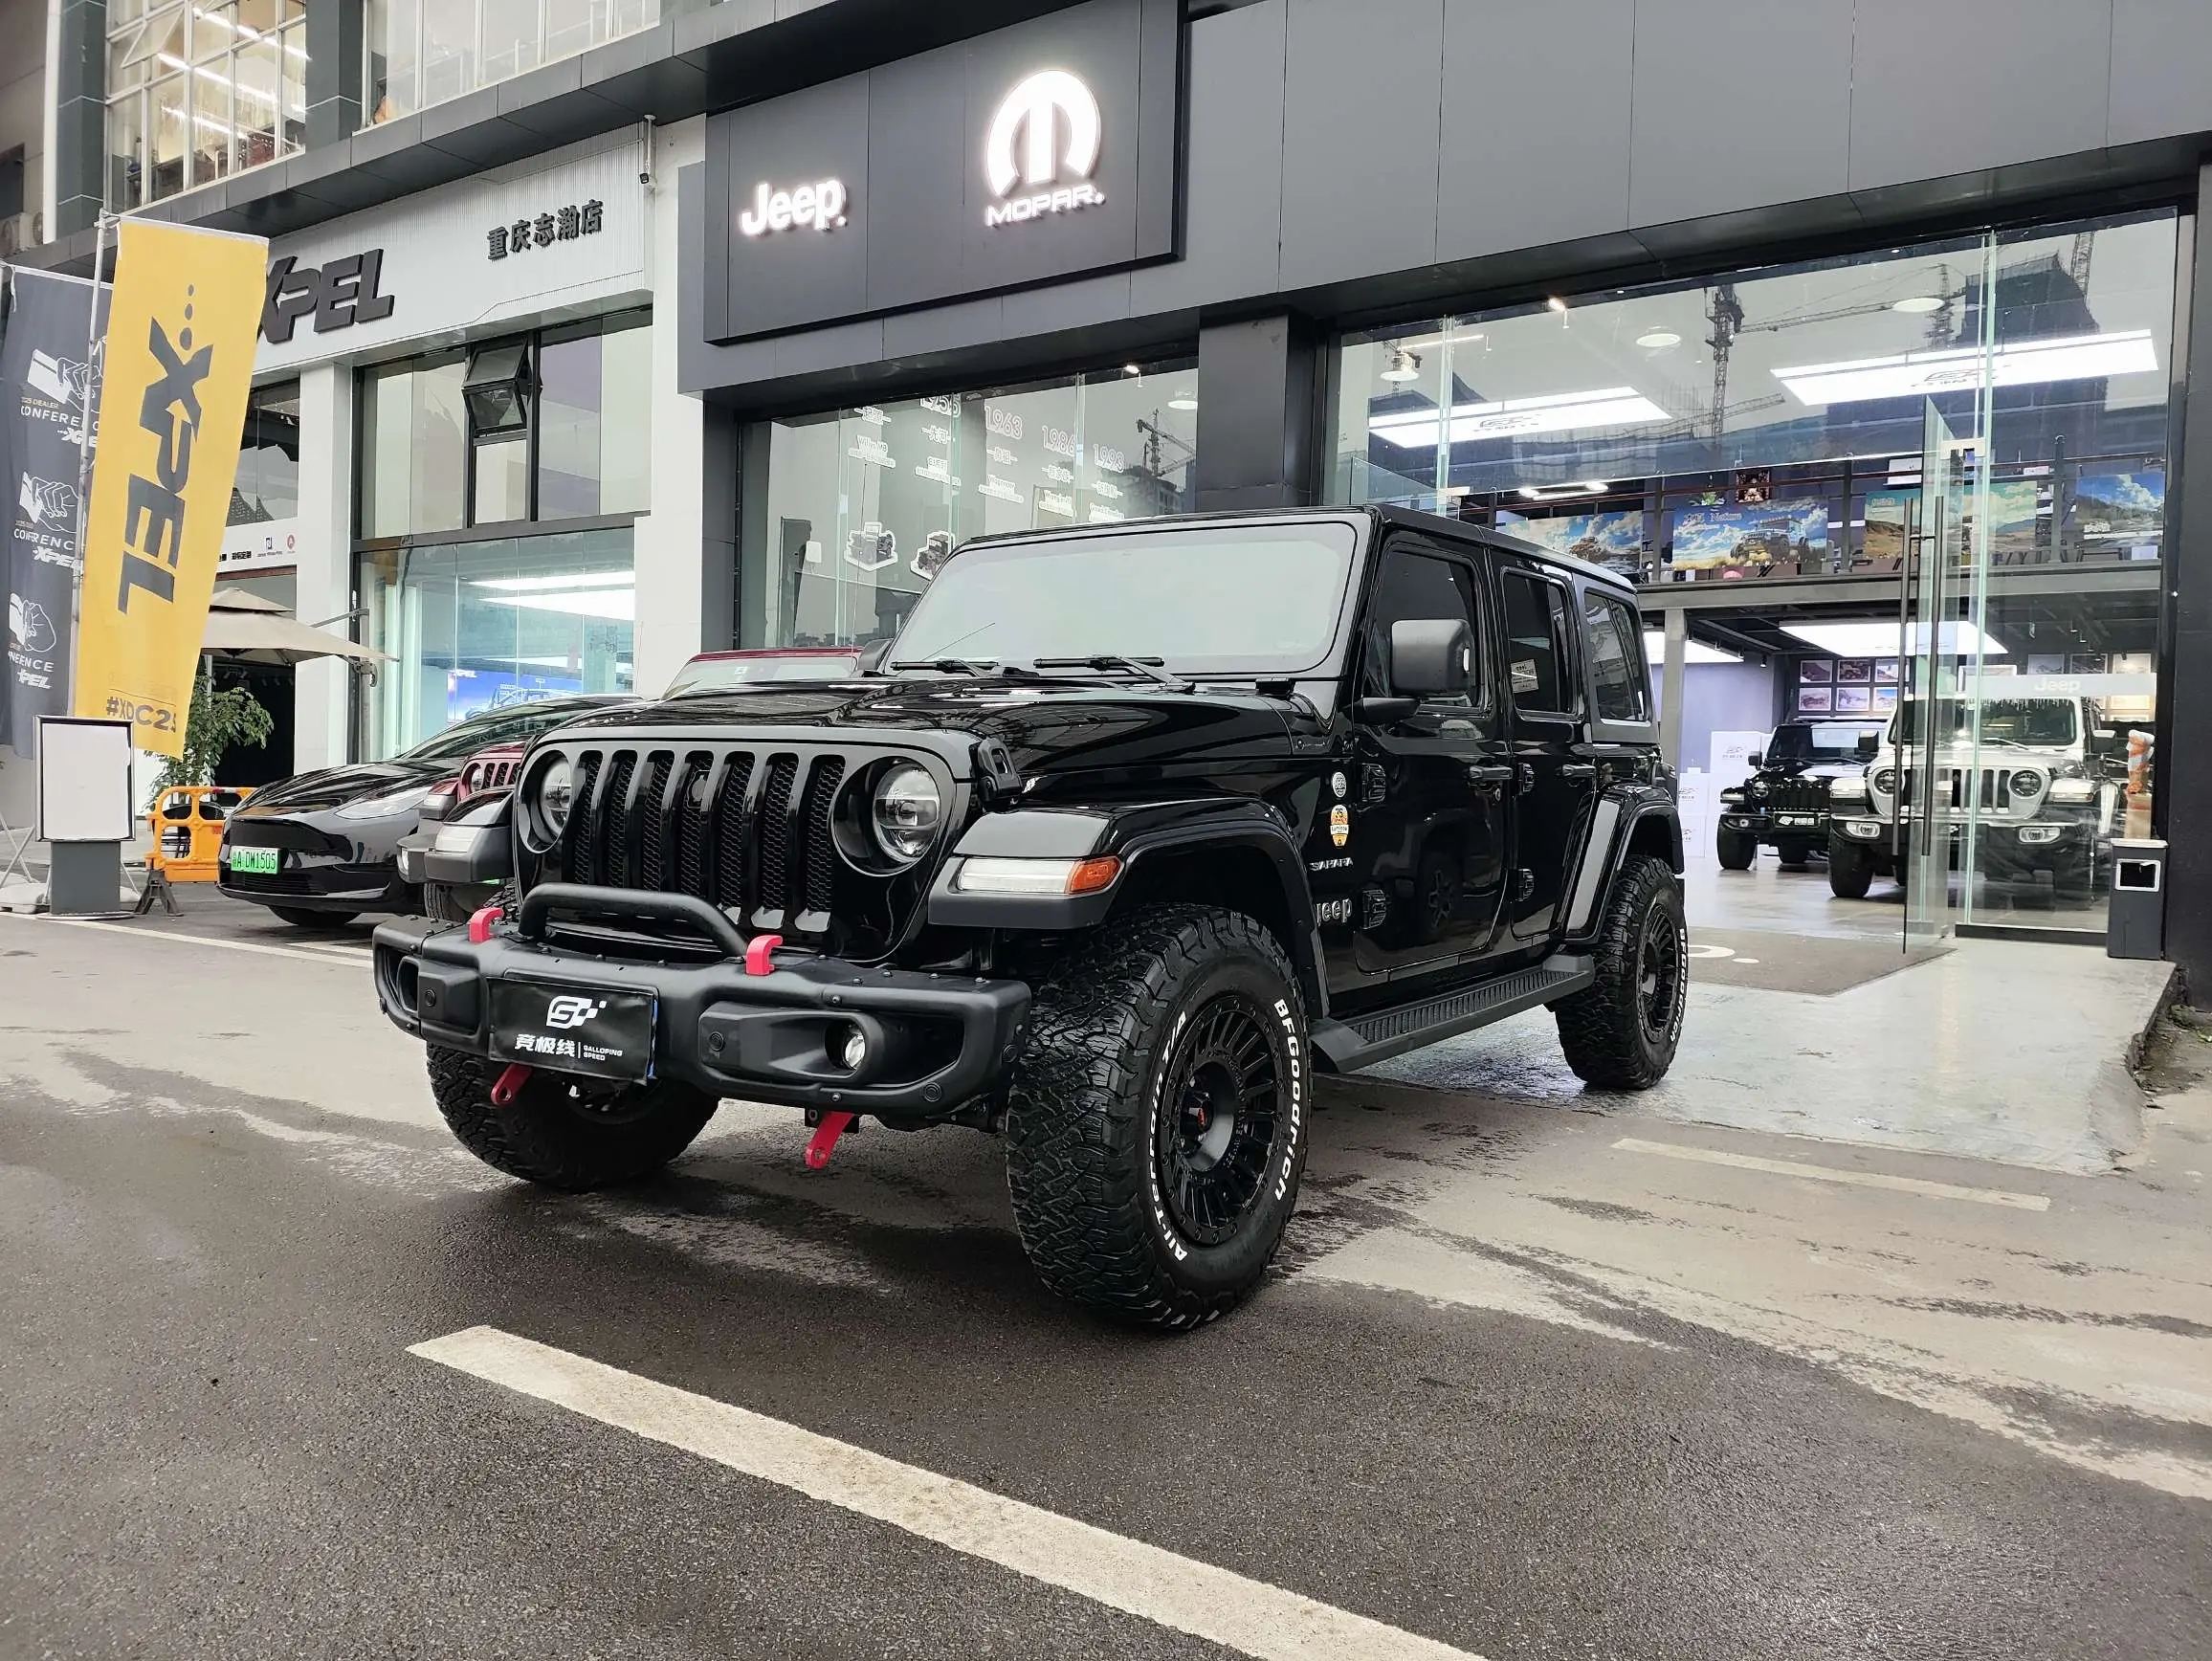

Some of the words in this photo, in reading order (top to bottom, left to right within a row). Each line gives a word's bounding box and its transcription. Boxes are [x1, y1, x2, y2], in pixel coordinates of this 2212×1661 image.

[984, 405, 1022, 440] 1963
[1042, 426, 1075, 456] 1986
[117, 316, 214, 614] XPEL
[515, 1033, 576, 1058] 竞极线
[583, 1045, 624, 1057] GALLOPING
[583, 1052, 606, 1061] SPEED
[1274, 999, 1301, 1201] BFGoodrich
